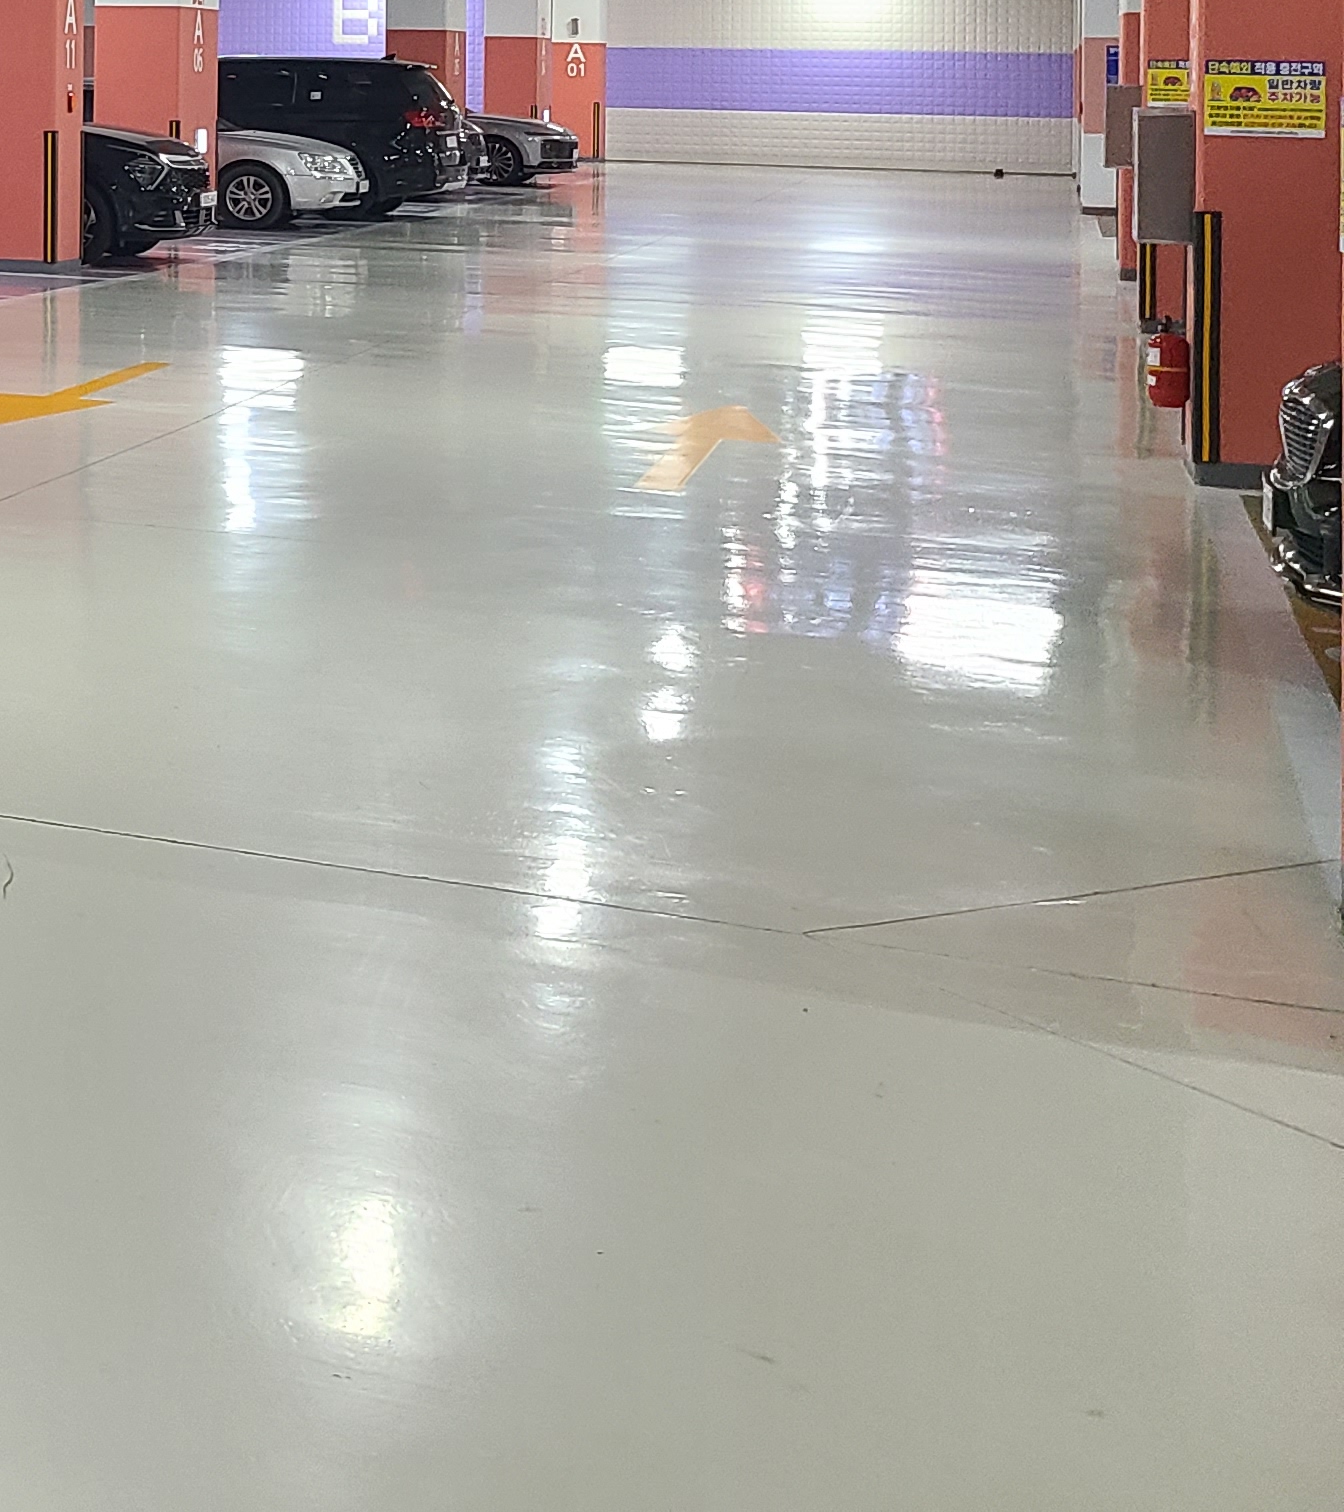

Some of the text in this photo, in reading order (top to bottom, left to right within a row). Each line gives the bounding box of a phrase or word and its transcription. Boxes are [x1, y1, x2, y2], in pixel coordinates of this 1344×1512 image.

[193, 9, 204, 45] A
[65, 39, 76, 69] 11
[193, 48, 204, 73] 06
[566, 43, 587, 63] A
[566, 63, 586, 77] 01
